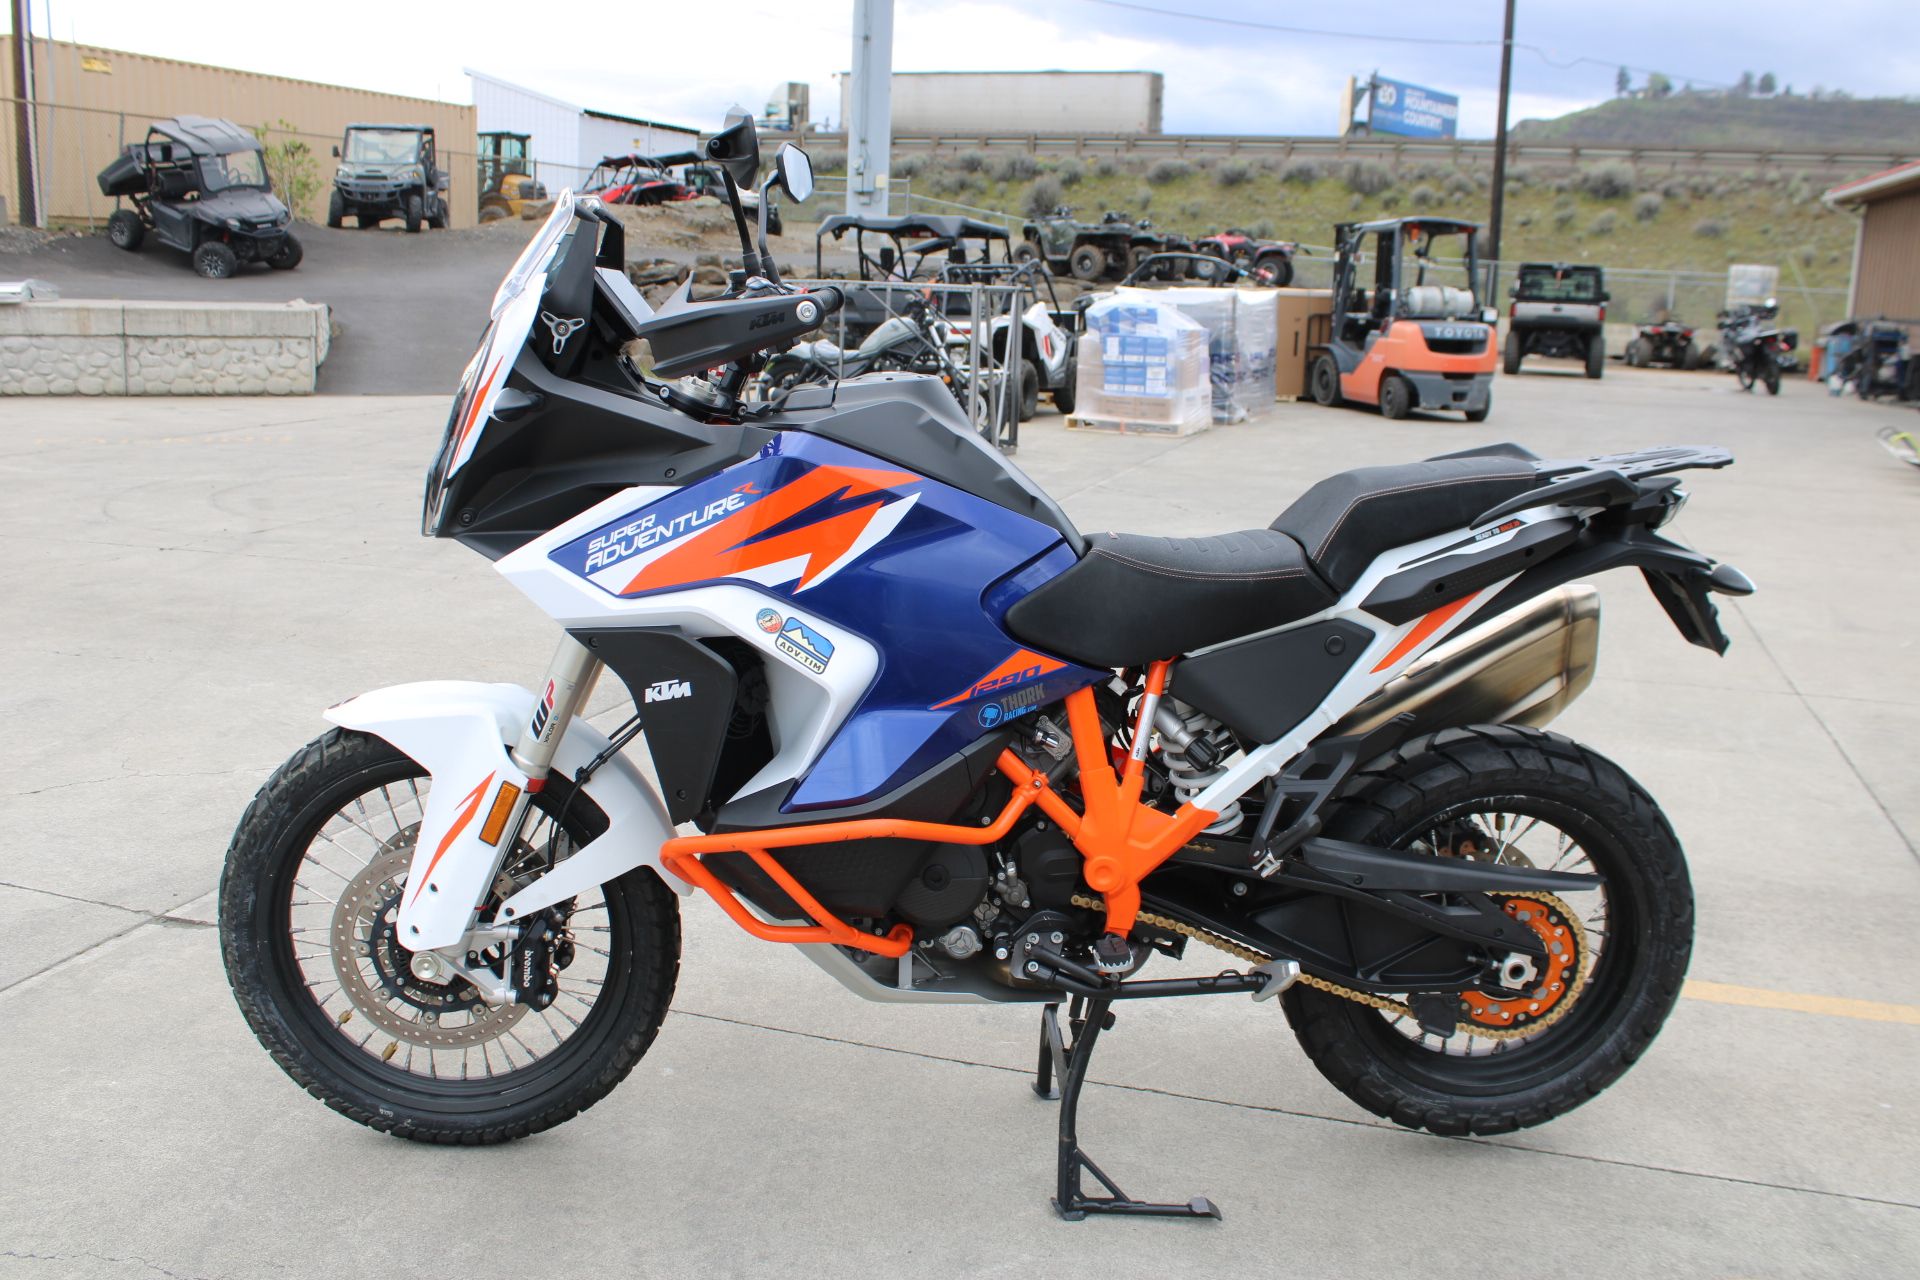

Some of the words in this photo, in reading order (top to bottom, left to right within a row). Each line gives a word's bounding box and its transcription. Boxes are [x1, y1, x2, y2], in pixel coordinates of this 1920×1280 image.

[749, 311, 785, 330] KTM
[584, 493, 746, 573] ADVENTURE
[587, 513, 656, 555] SUPER
[779, 641, 822, 672] ADV-TIM
[644, 679, 692, 704] KTM
[523, 949, 534, 988] brembo
